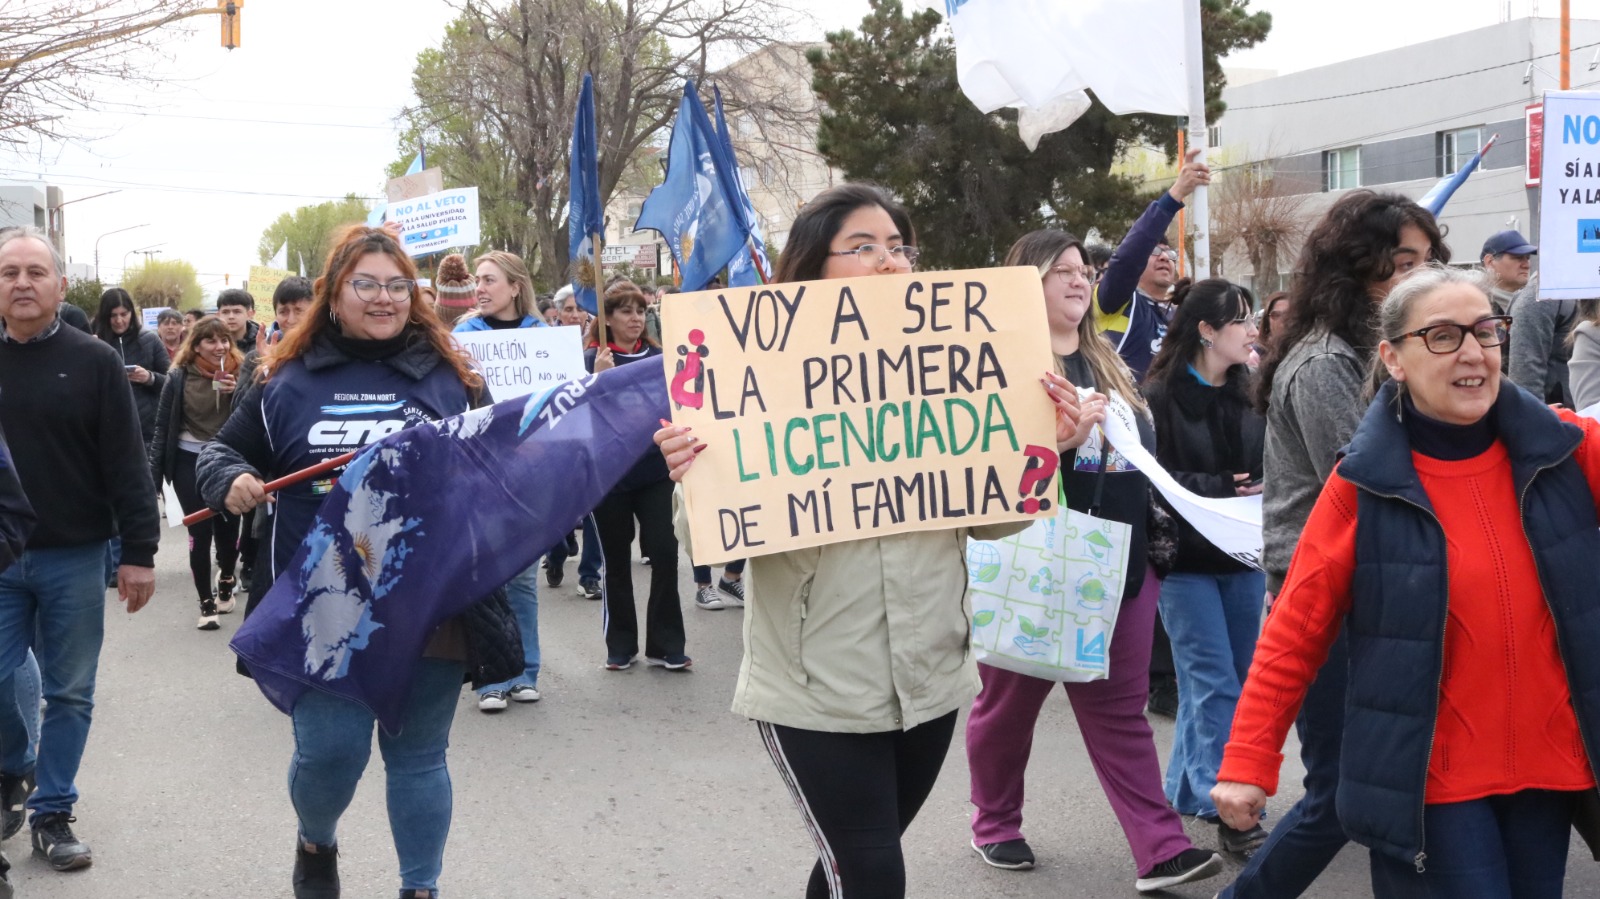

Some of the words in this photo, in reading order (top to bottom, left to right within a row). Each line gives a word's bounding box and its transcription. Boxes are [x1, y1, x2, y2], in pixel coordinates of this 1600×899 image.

[1562, 114, 1600, 146] NO
[1564, 157, 1580, 178] SÍ
[1583, 162, 1593, 178] A
[395, 205, 414, 217] NO
[416, 201, 432, 212] AL
[434, 195, 467, 208] VETO
[1559, 188, 1569, 204] Y
[1571, 188, 1581, 204] A
[416, 219, 438, 229] SALUD
[420, 208, 465, 221] UNIVERSIDAD
[600, 246, 631, 255] OTEL
[717, 285, 806, 353] VOY
[830, 285, 870, 345] A
[902, 281, 997, 334] SER
[535, 348, 549, 359] es
[485, 365, 532, 387] RECHO
[538, 372, 552, 381] NO
[556, 372, 567, 381] UN
[802, 341, 1008, 410] PRIMERA
[333, 393, 360, 401] REGIONAL
[360, 393, 376, 401] ZONA
[376, 393, 396, 401] NORTE
[402, 406, 423, 417] SANTA
[732, 392, 1021, 483] LICENCIADA
[718, 504, 766, 552] DE
[787, 477, 834, 537] MÍ
